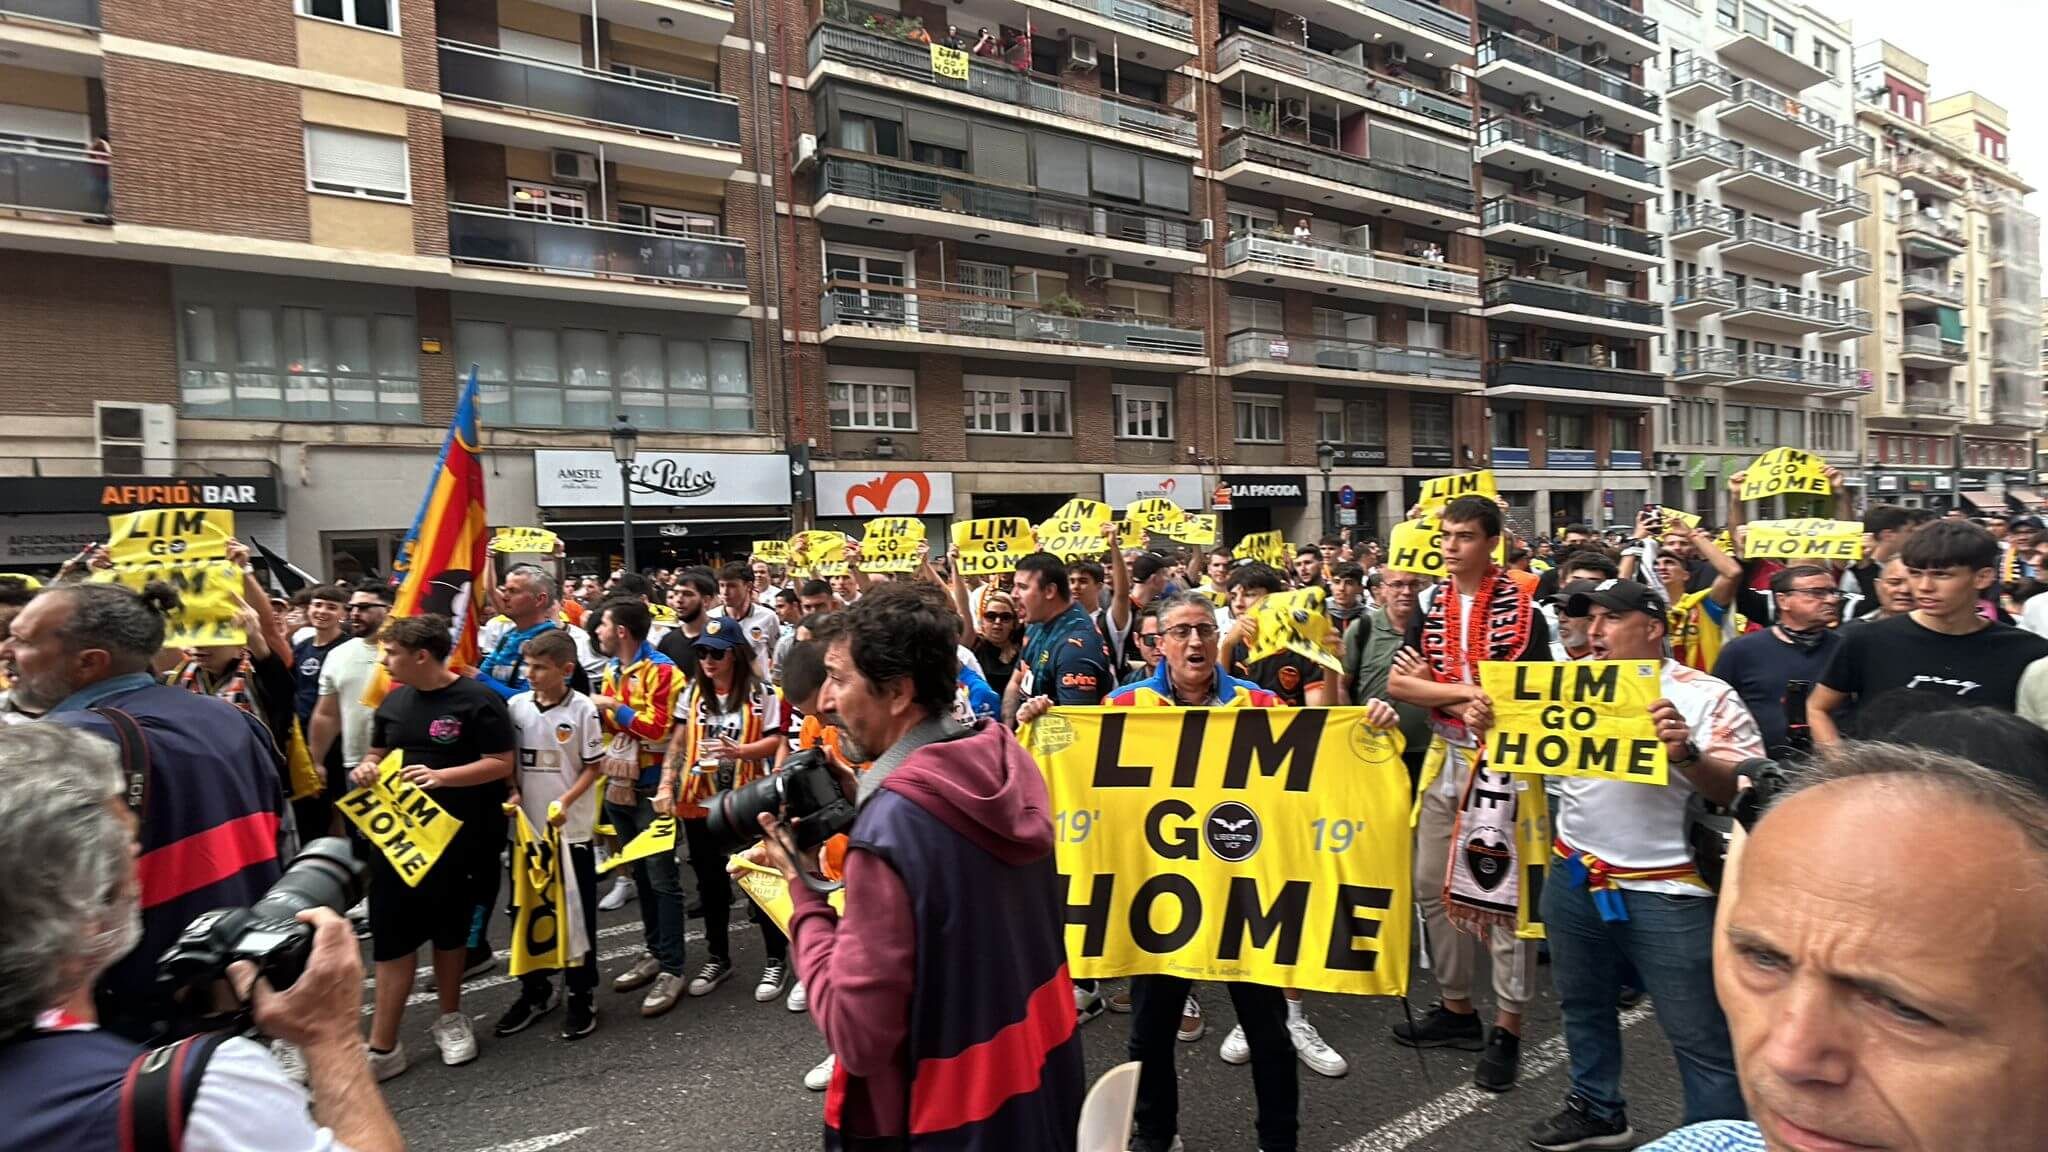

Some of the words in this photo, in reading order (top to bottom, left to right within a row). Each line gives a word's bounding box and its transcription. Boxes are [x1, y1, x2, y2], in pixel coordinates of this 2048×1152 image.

[1759, 450, 1808, 467] LIM
[558, 469, 602, 479] AMSTEL
[1770, 463, 1798, 476] GO
[203, 484, 257, 503] BAR
[1231, 485, 1249, 497] LA
[1250, 485, 1301, 497] PAGODA
[1431, 473, 1478, 498] LIM
[1745, 476, 1825, 496] HOME
[1138, 499, 1171, 513] LIM
[129, 511, 207, 538] LIM
[870, 519, 908, 539] LIM
[970, 518, 1018, 540] LIM
[877, 539, 898, 552] GO
[1752, 539, 1857, 555] HOME
[962, 553, 1017, 571] HOM
[1394, 547, 1444, 571] HO
[1514, 665, 1619, 702] LIM
[1540, 705, 1597, 731] GO
[1092, 708, 1329, 793] LIM
[1494, 732, 1659, 775] HOME
[384, 770, 441, 828] LIM
[344, 790, 429, 878] HOME
[1056, 872, 1394, 972] HOME
